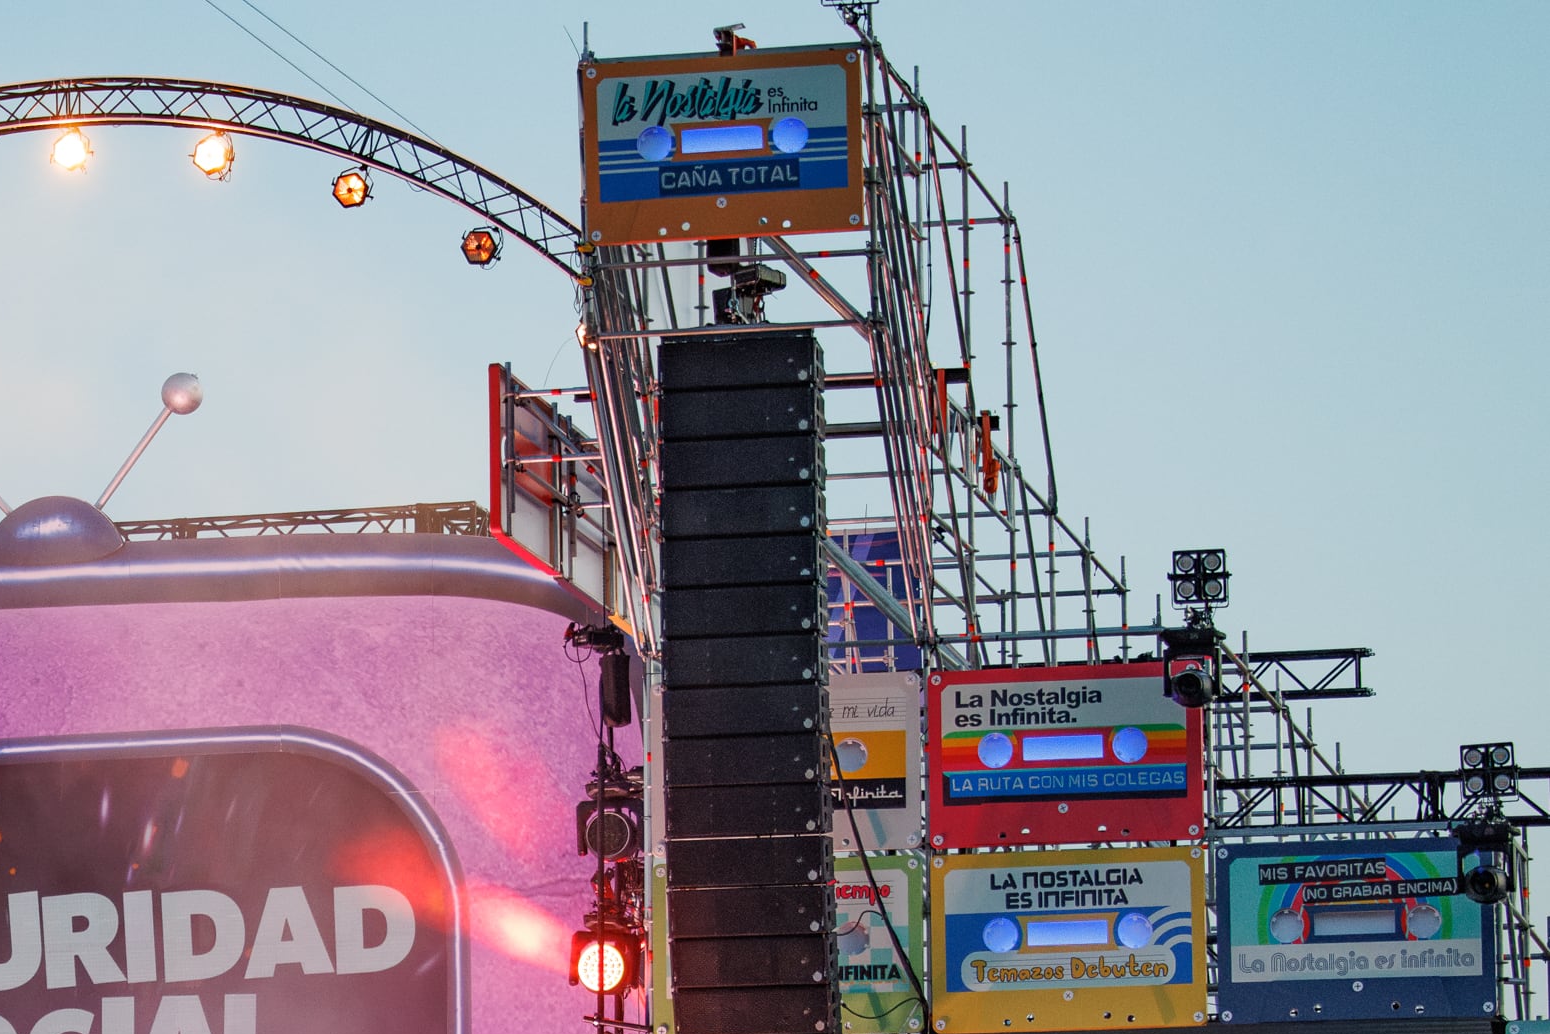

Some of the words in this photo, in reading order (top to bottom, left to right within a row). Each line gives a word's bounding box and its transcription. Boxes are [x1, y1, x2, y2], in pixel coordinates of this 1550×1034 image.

[612, 81, 637, 126] la
[640, 75, 767, 126] Nostalgia
[767, 85, 784, 98] es
[768, 96, 818, 114] Infinita
[661, 165, 723, 189] CAÑA
[728, 165, 798, 184] TOTAL
[867, 697, 895, 718] vida
[954, 690, 982, 709] La
[990, 686, 1102, 710] Nostalgia
[954, 711, 982, 728] es
[989, 706, 1078, 726] Infinita.
[951, 777, 973, 792] LA
[977, 775, 1024, 791] RUTA
[1028, 774, 1065, 789] CON
[1068, 773, 1099, 787] MIS
[1103, 771, 1185, 787] COLEGAS
[990, 873, 1017, 890] LA
[1022, 868, 1143, 889] NOSTALGIA
[1259, 867, 1289, 881] MIS
[1294, 861, 1387, 879] FAVORITAS
[1005, 892, 1033, 909] ES
[1037, 888, 1129, 908] INFINITA
[1302, 887, 1327, 903] (NO
[1332, 883, 1392, 898] GRABAR
[1397, 879, 1459, 896] ENCIMA)
[970, 958, 1065, 983] Temazos
[1069, 953, 1169, 980] Debuten
[1238, 953, 1265, 974] La
[1270, 950, 1369, 976] Nostalgia
[1374, 952, 1397, 969] es
[1400, 947, 1475, 970] infinita
